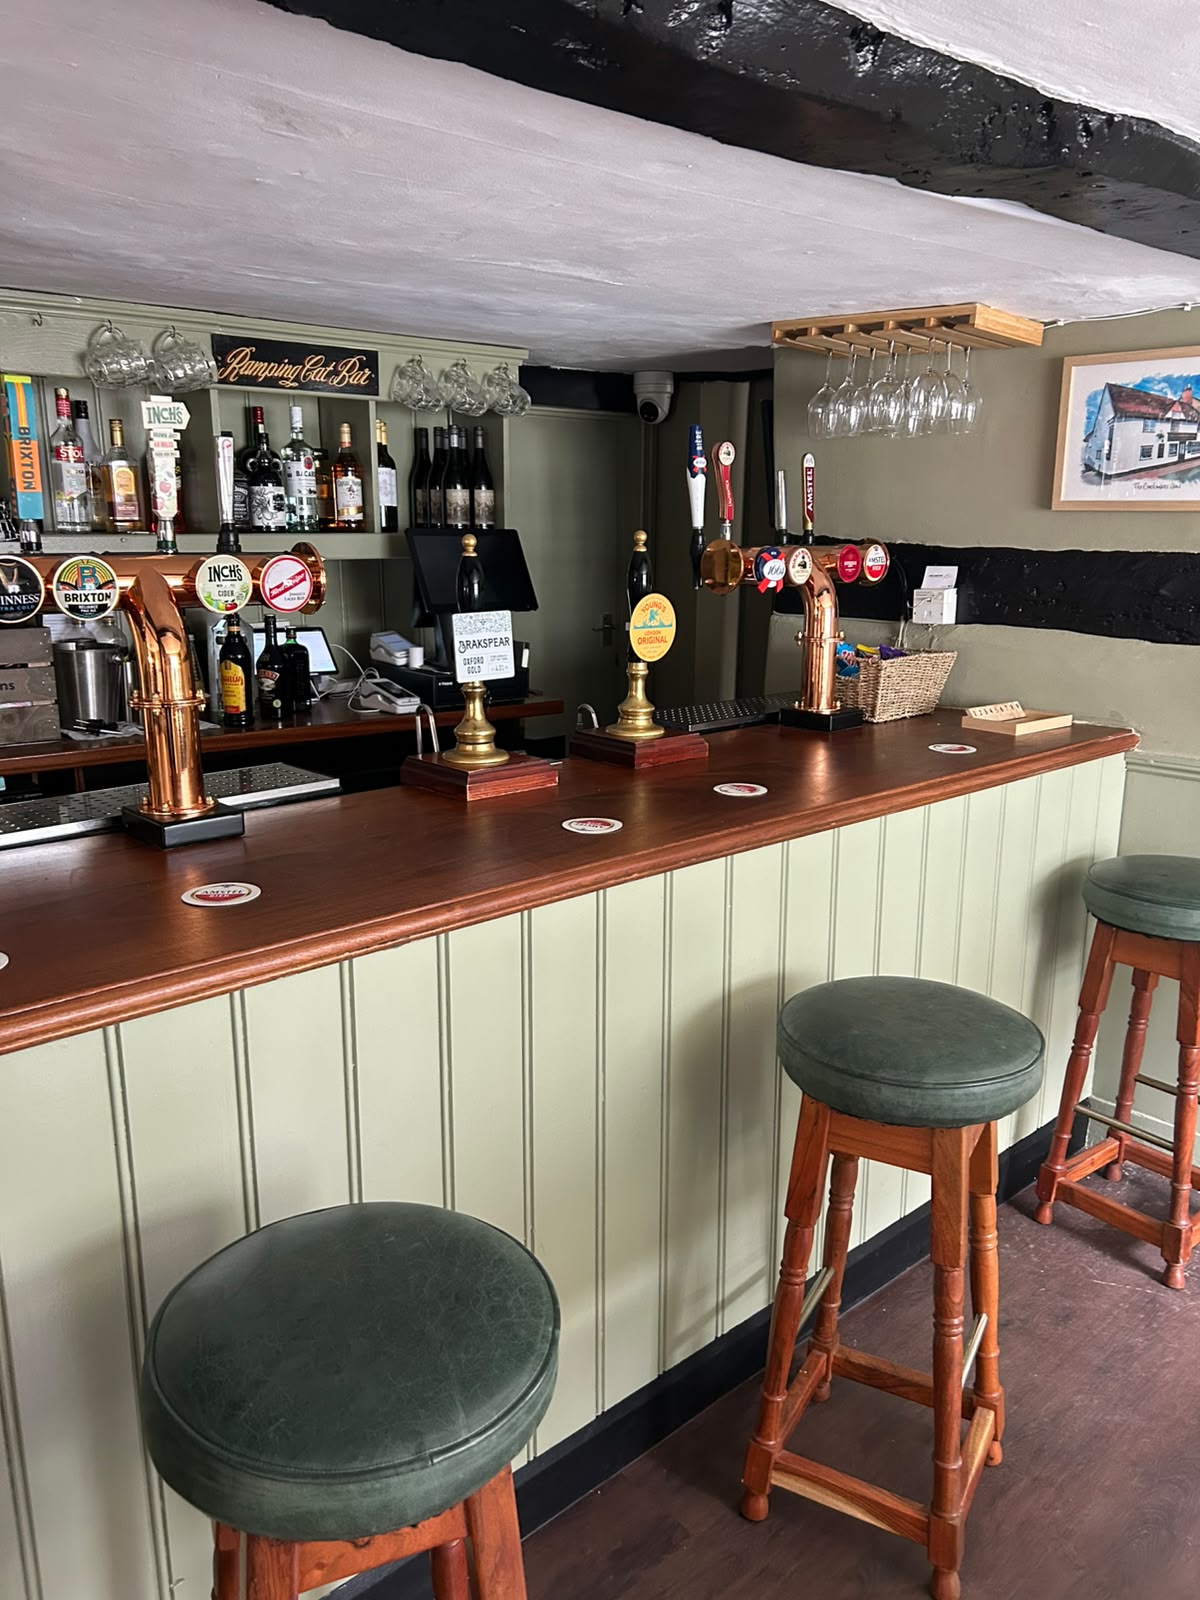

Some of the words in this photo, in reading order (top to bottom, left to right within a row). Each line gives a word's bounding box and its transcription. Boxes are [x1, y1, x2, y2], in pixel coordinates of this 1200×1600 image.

[218, 347, 302, 387] Ramping
[300, 355, 335, 382] Cat
[328, 355, 371, 387] Bar
[146, 406, 183, 424] INCH'S
[18, 426, 37, 490] BRIXTON
[208, 564, 243, 582] INCH'S
[64, 592, 112, 603] BRIXTON
[641, 601, 667, 613] YOUNG'S
[458, 636, 511, 654] BRAKSPEAR
[637, 635, 669, 646] ORIGINAL
[463, 656, 485, 666] OXFORD
[467, 665, 481, 674] GOLD
